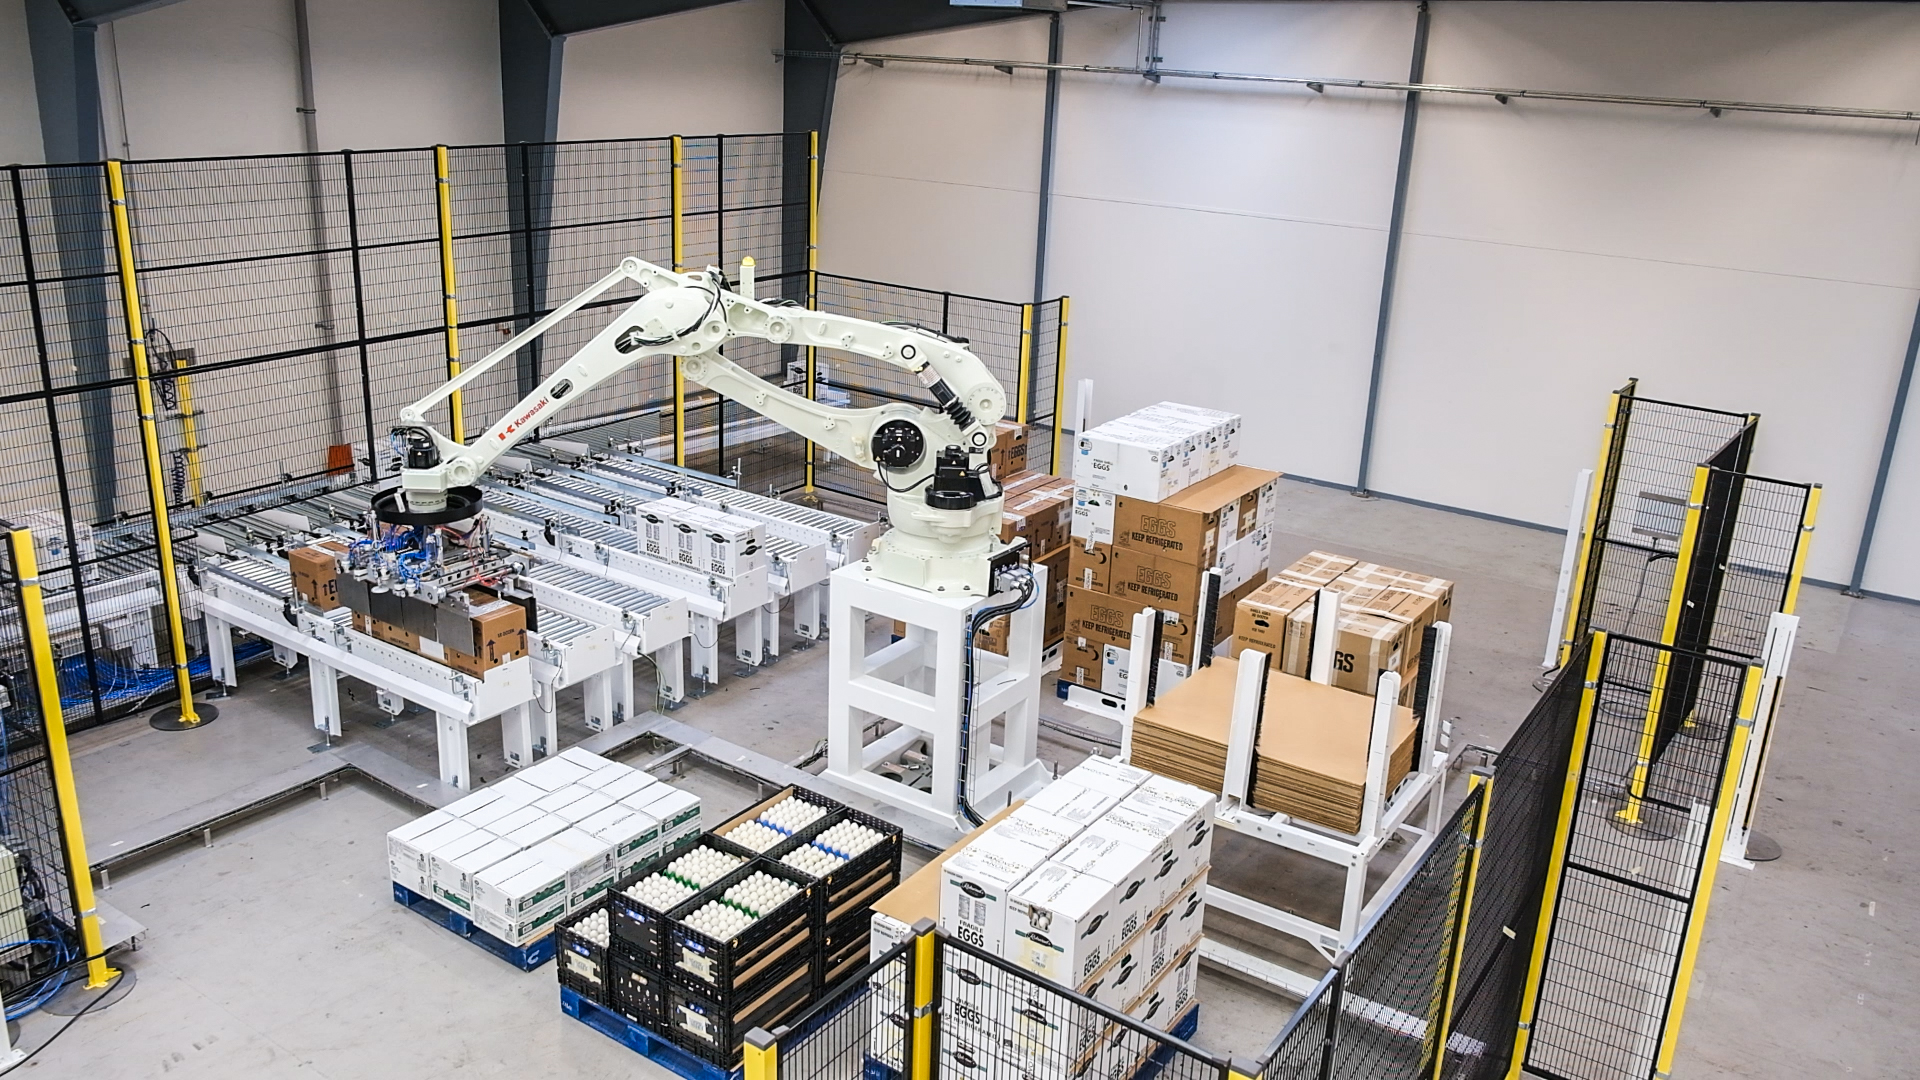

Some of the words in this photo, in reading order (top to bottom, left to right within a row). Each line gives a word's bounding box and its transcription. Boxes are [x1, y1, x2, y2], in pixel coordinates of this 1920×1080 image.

[514, 396, 550, 428] Kawasaki
[1093, 463, 1110, 471] EGGS
[1141, 515, 1176, 538] EGGS
[647, 543, 660, 554] EGGS
[1132, 532, 1145, 540] KEEP
[1146, 534, 1183, 550] REFRIGERATED
[679, 553, 692, 564] EGGS
[711, 562, 725, 574] EGGS
[1136, 566, 1172, 589] EGGS
[1128, 582, 1140, 592] KEEP
[1141, 585, 1178, 601] REFRIGERATED
[1090, 605, 1124, 628] EGGS
[1082, 620, 1094, 630] KEEP
[1095, 624, 1131, 640] REFRIGERATED
[1334, 650, 1355, 673] GS
[958, 926, 984, 947] EGGS
[960, 920, 983, 934] FRAGILE
[1122, 917, 1137, 940] EGGS
[1084, 950, 1100, 976] EGGS
[1151, 954, 1165, 976] EGGS
[955, 1002, 980, 1024] EGGS
